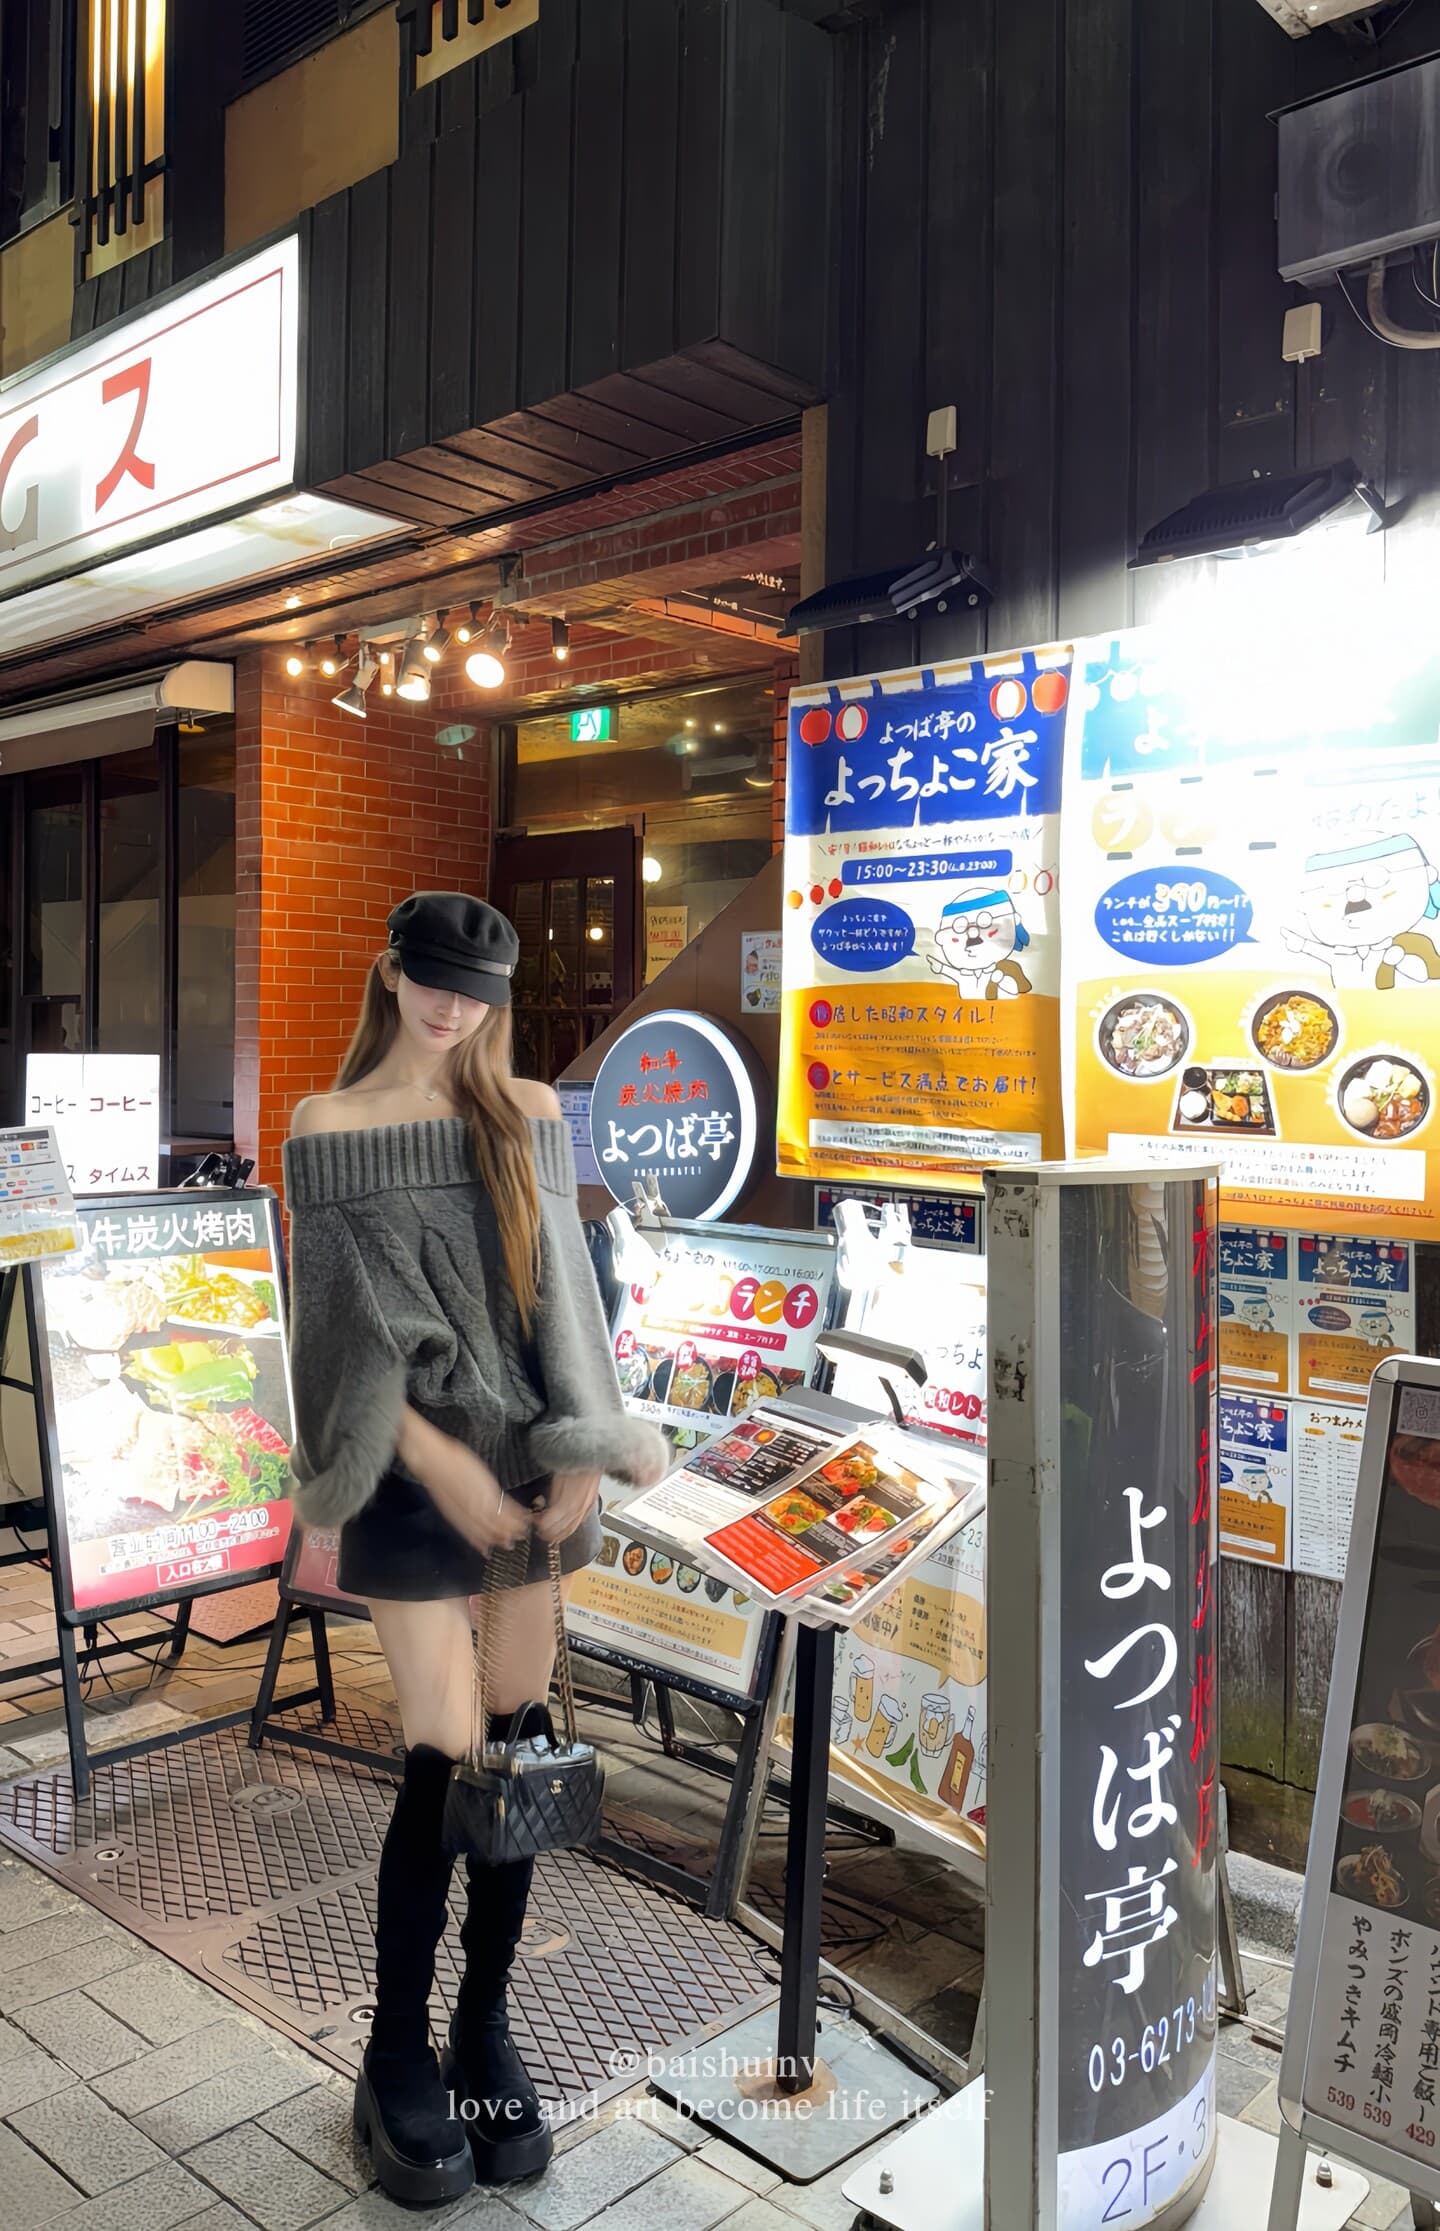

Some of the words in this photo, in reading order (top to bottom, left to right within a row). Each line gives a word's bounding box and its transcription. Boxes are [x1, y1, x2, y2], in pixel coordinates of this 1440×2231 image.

[879, 710, 976, 744] よつば亭の
[824, 727, 1039, 806] よっちょこ家
[640, 1048, 682, 1075] 和牛
[89, 1095, 153, 1113] コーヒー
[618, 1080, 710, 1107] 炭火焼肉
[602, 1110, 735, 1163] よつば亭
[1083, 1486, 1183, 1995] よつば亭
[1327, 2086, 1356, 2112] 539
[1363, 2102, 1393, 2128] 539
[1405, 2122, 1436, 2148] 429
